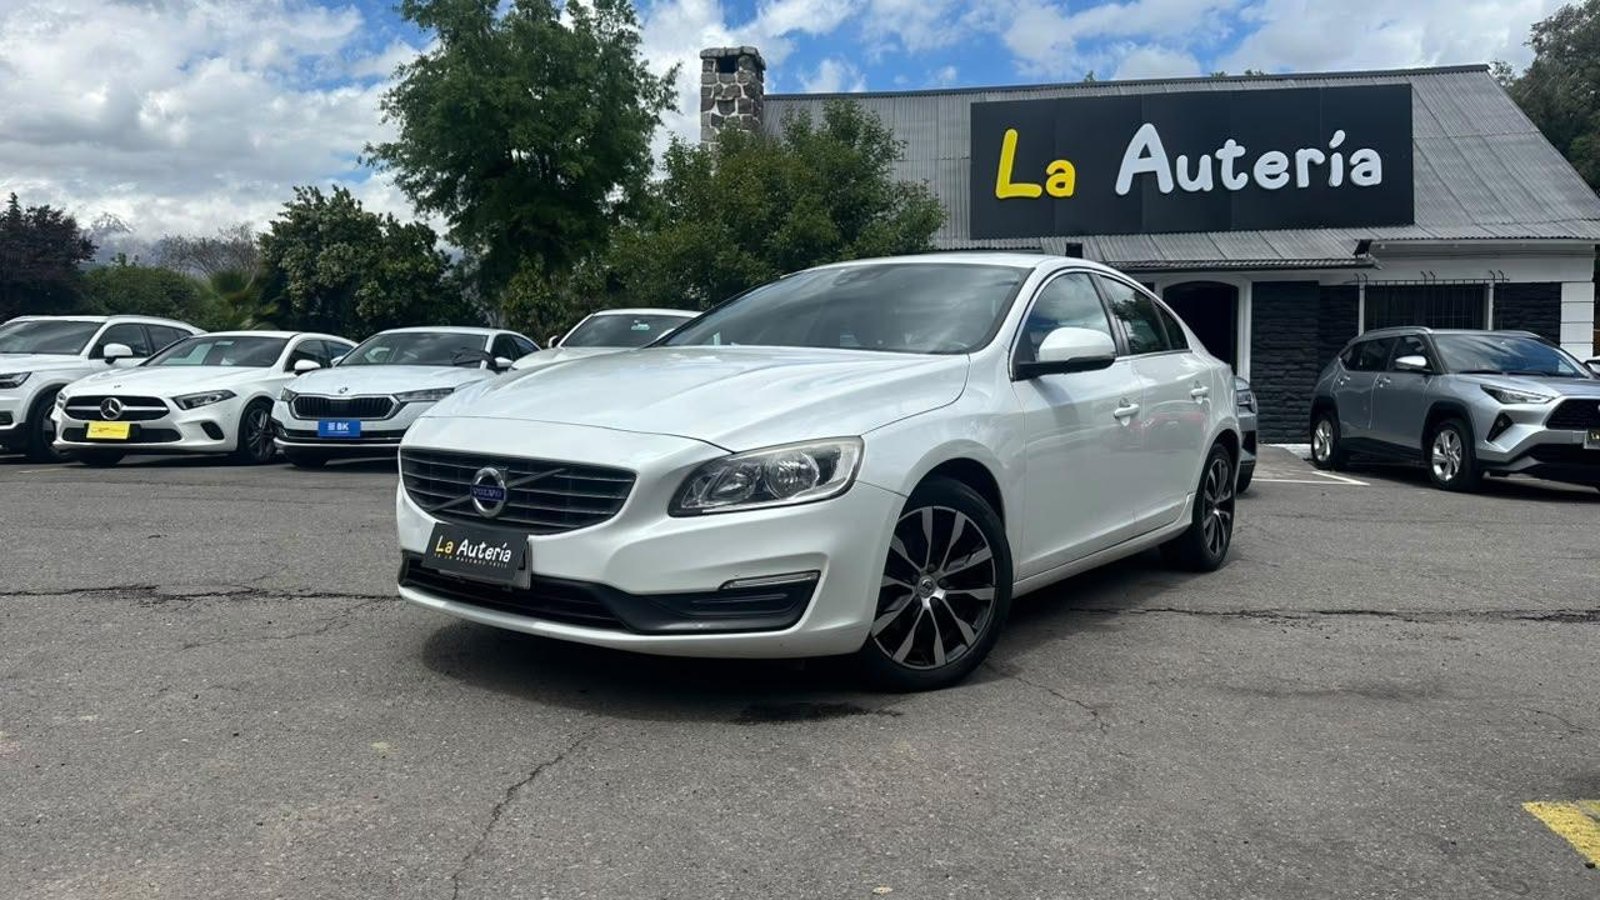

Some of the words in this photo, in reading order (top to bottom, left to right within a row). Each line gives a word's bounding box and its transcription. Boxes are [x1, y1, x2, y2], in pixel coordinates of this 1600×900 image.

[995, 128, 1076, 199] La
[1115, 123, 1383, 196] Autería
[472, 487, 502, 498] VOLVO
[435, 535, 454, 554] La
[456, 538, 512, 563] Autería
